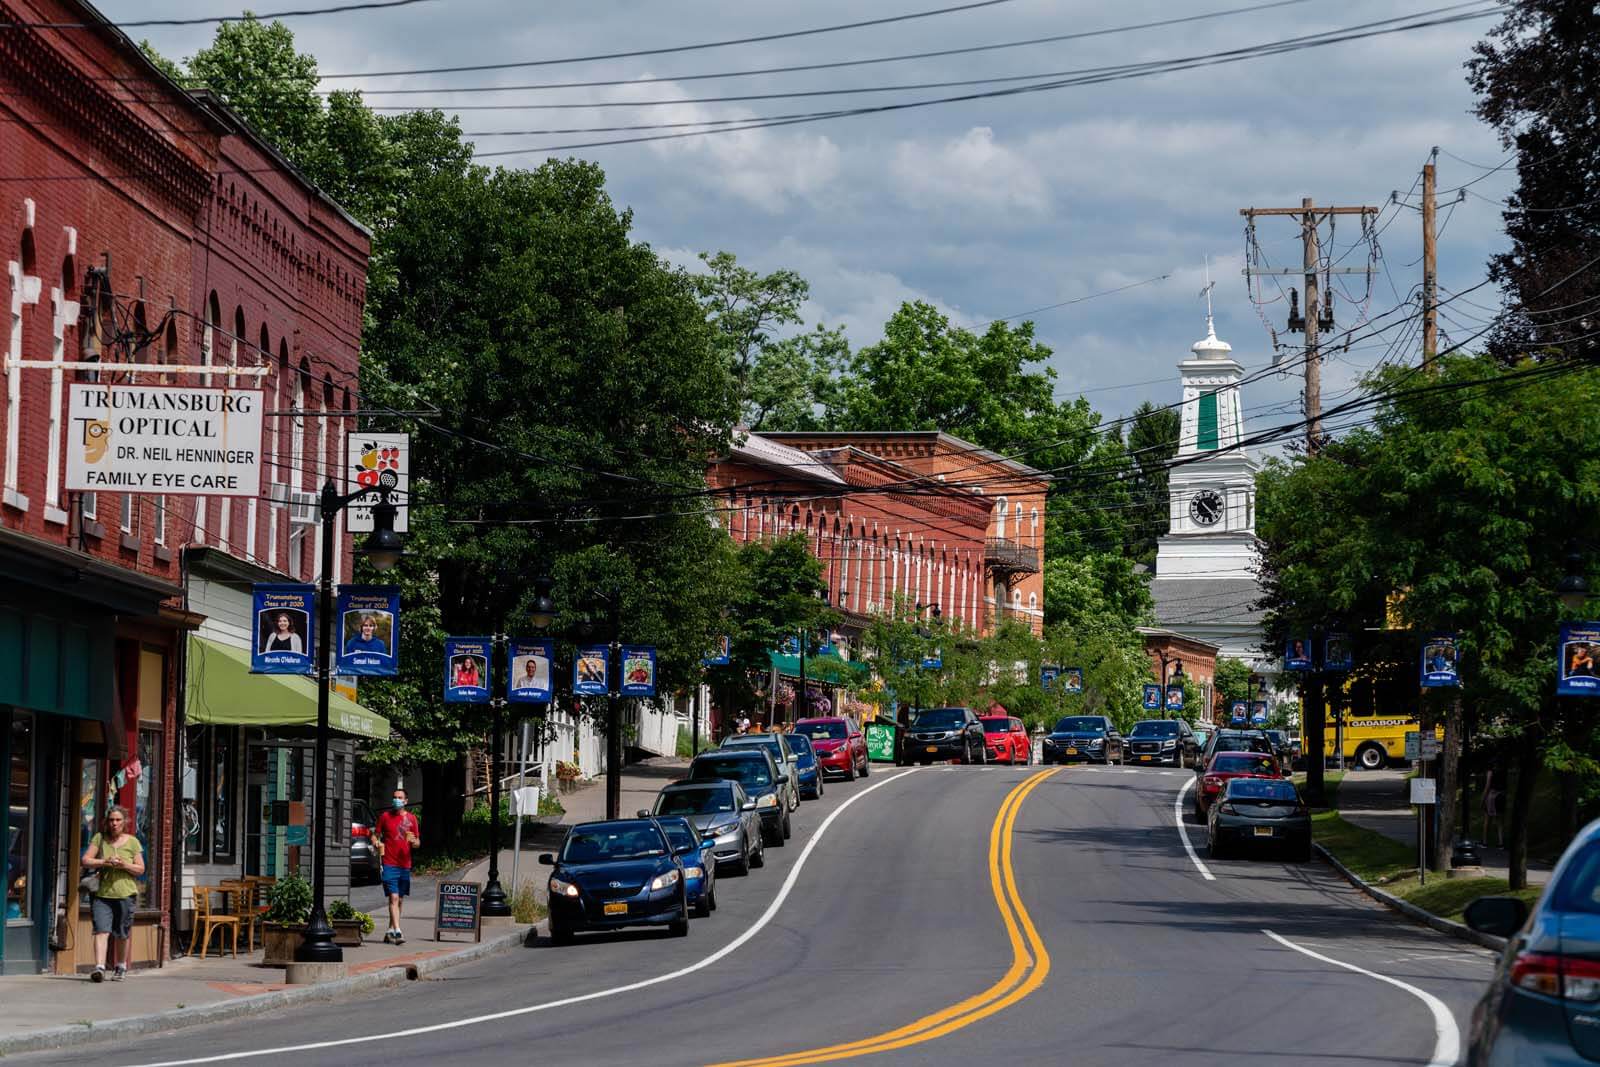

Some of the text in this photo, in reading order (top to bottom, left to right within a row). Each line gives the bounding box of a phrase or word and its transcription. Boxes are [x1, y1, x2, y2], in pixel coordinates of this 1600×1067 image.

[81, 390, 251, 414] TRUMANSBURG
[119, 417, 216, 438] OPTICAL
[117, 446, 254, 464] DR. NEIL HENNINGER
[87, 471, 238, 489] FAMILY EYE CARE
[356, 493, 399, 503] MAN
[1352, 719, 1406, 727] GADABOUT
